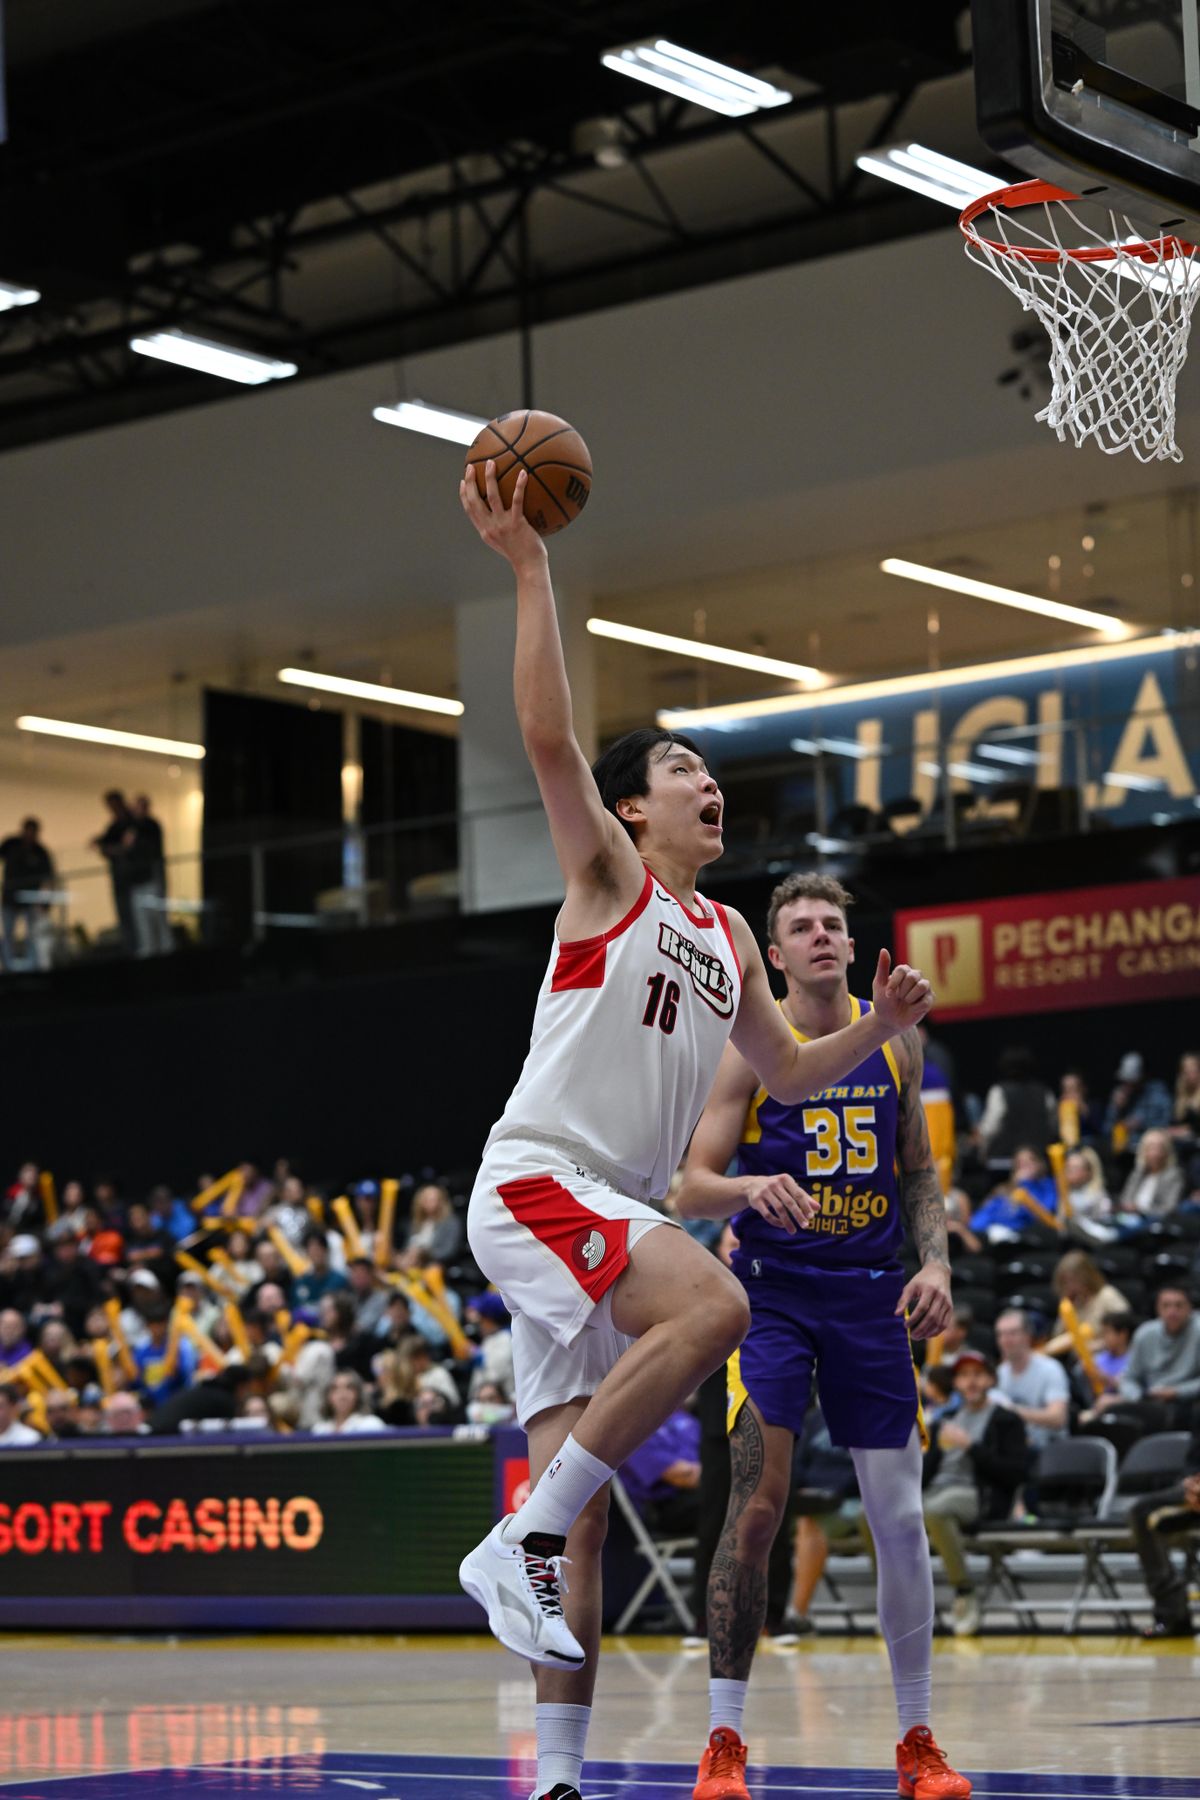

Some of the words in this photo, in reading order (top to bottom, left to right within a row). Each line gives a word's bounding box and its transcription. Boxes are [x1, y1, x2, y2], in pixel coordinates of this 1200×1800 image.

[854, 670, 1197, 836] UCLA
[994, 903, 1200, 958] PECHANG
[658, 922, 734, 1016] Remix
[995, 954, 1101, 988] RESORT
[642, 971, 681, 1035] 16
[809, 1085, 849, 1102] UTH
[851, 1084, 890, 1099] BAY
[802, 1105, 878, 1177] 35
[811, 1182, 889, 1229] ibigo
[123, 1497, 324, 1553] CASINO
